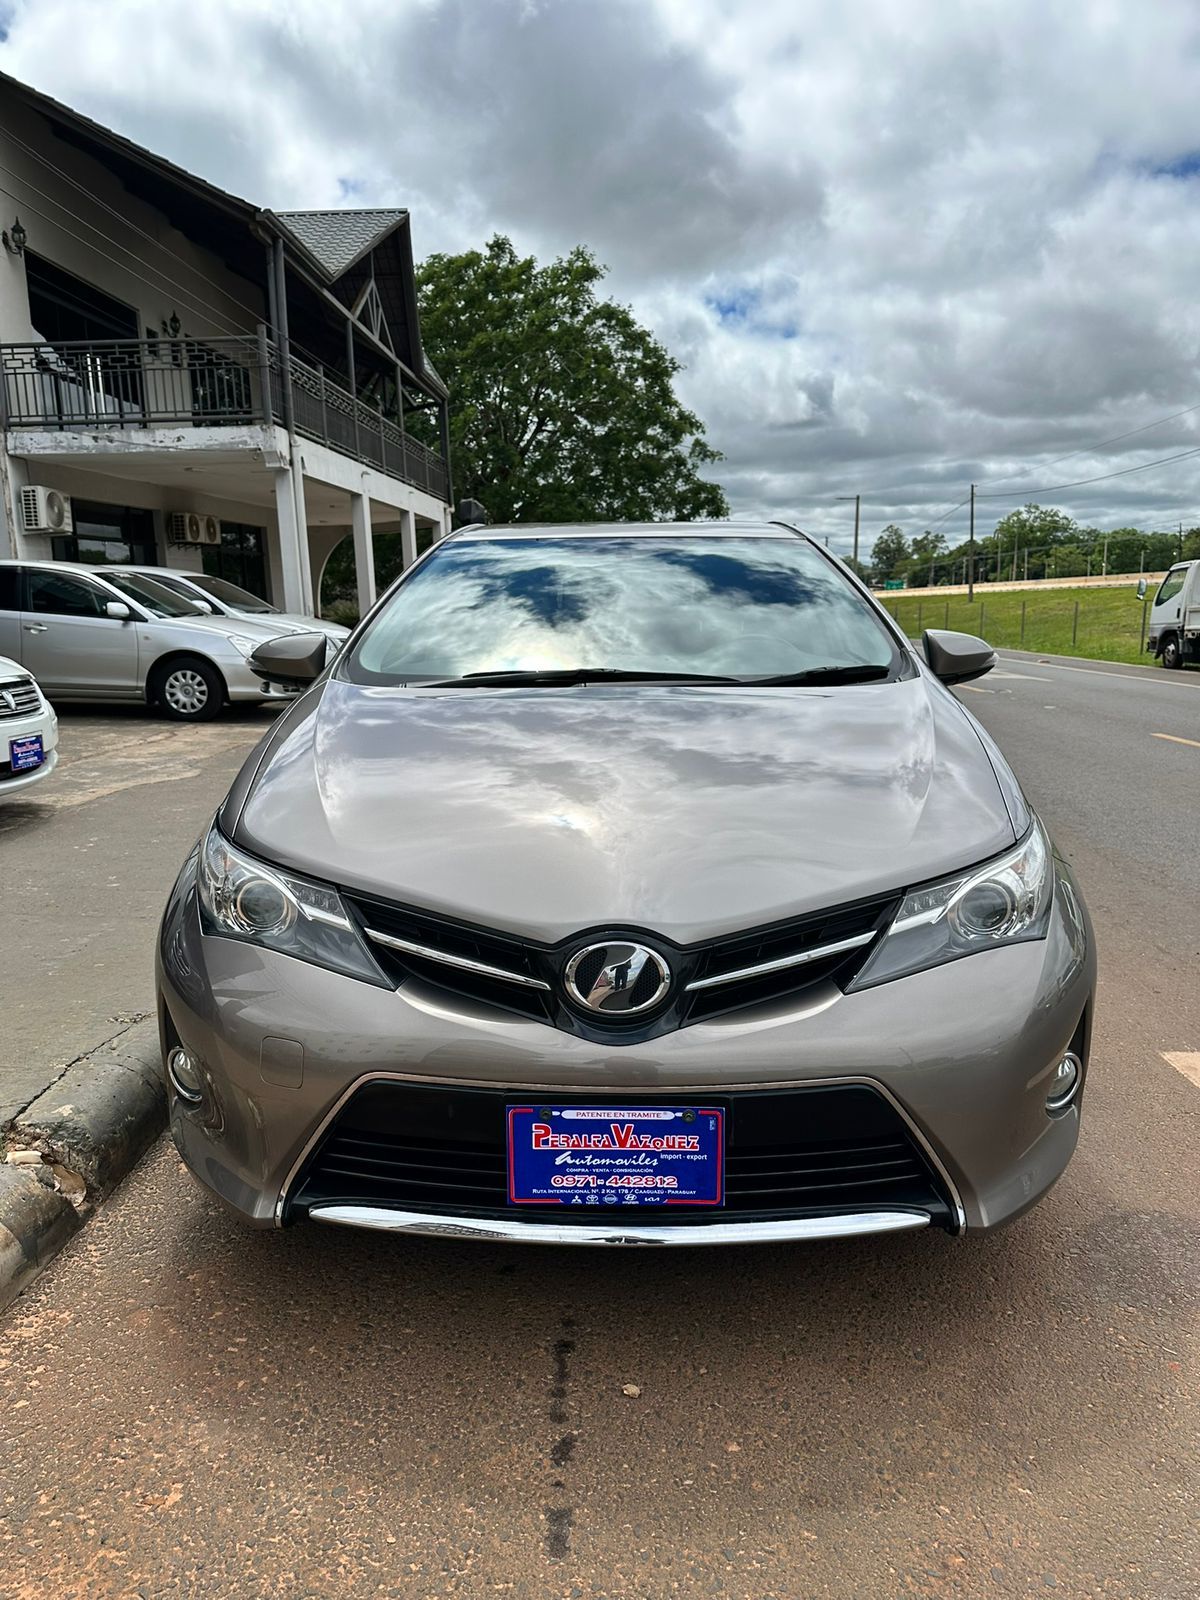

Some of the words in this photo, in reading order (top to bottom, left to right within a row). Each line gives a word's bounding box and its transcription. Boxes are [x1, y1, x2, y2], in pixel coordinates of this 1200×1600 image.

[532, 1123, 613, 1149] PERALTA
[610, 1124, 699, 1151] VAZQUEZ
[554, 1150, 658, 1166] Automoviles
[551, 1174, 678, 1188] 0971-442812
